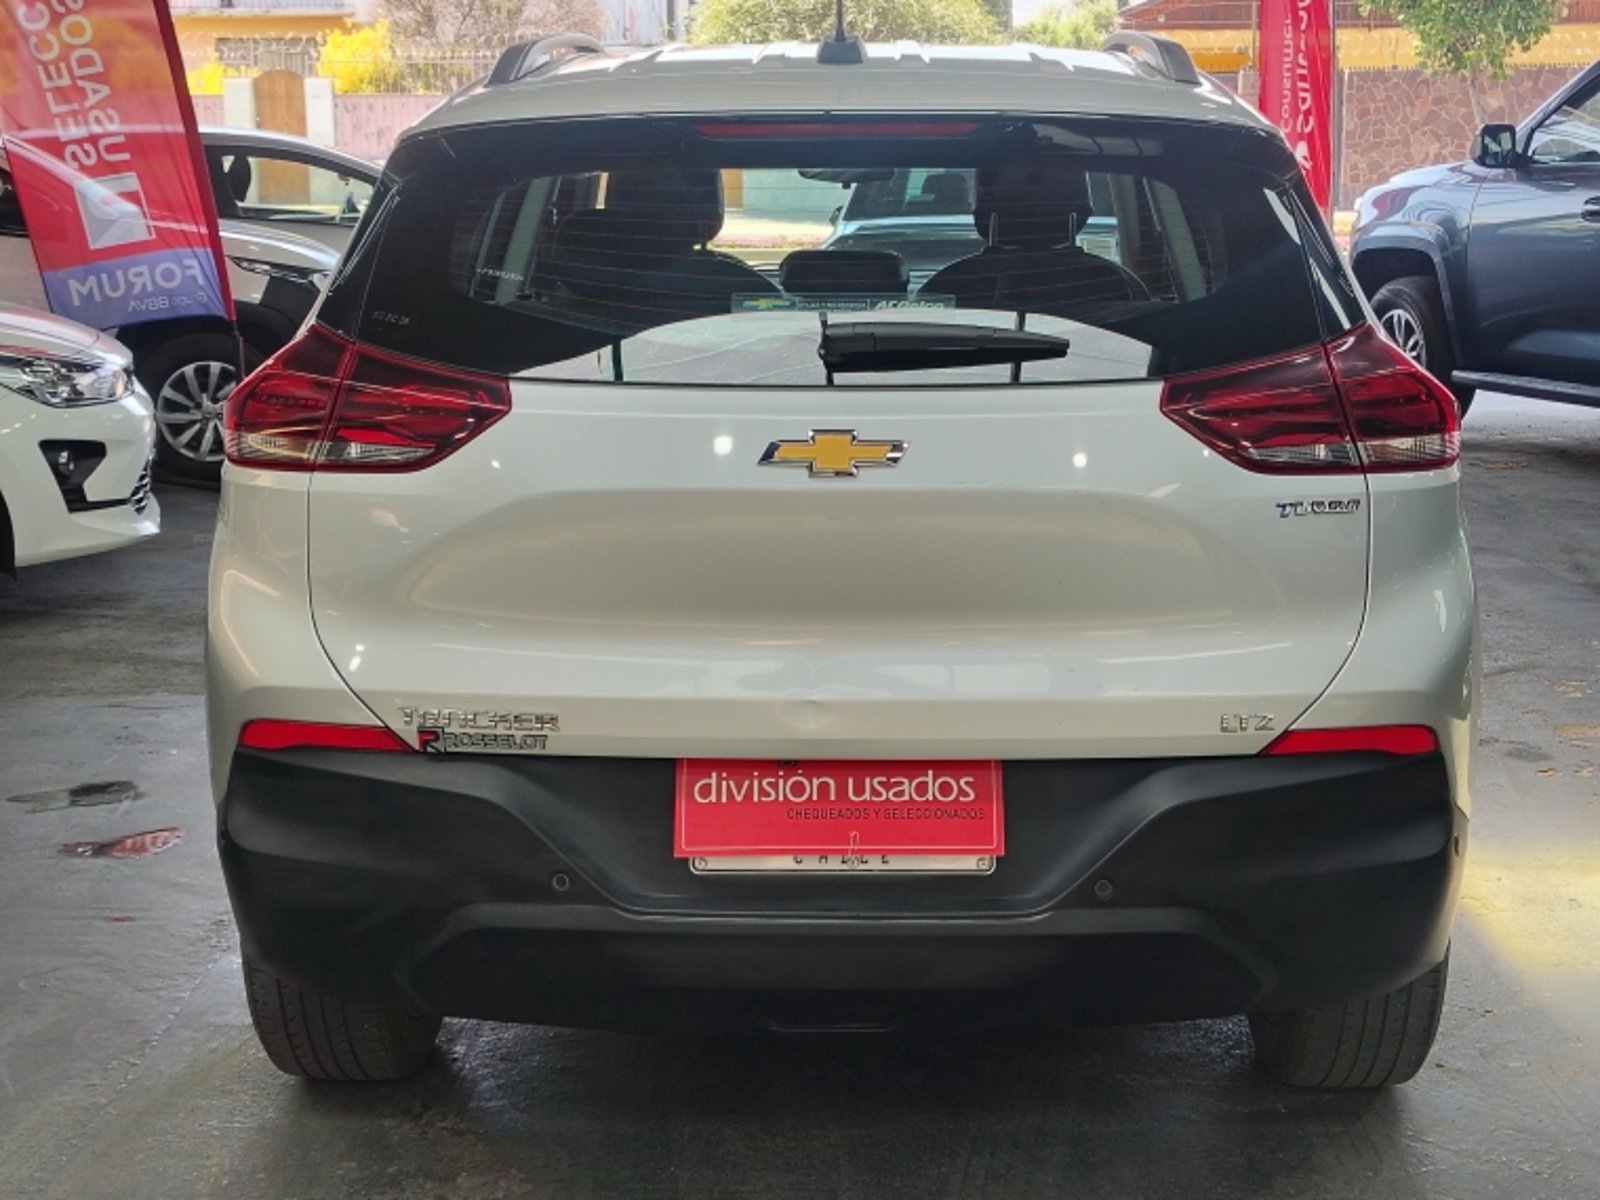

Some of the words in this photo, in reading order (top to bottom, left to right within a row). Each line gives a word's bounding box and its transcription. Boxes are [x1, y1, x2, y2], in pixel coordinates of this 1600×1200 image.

[399, 706, 560, 732] TRACKER
[1220, 713, 1275, 733] LTZ
[444, 732, 548, 750] ROSSELOT
[693, 769, 836, 803] división
[848, 770, 976, 802] usados
[786, 807, 869, 820] CHEQUEADOS
[874, 807, 882, 819] Y
